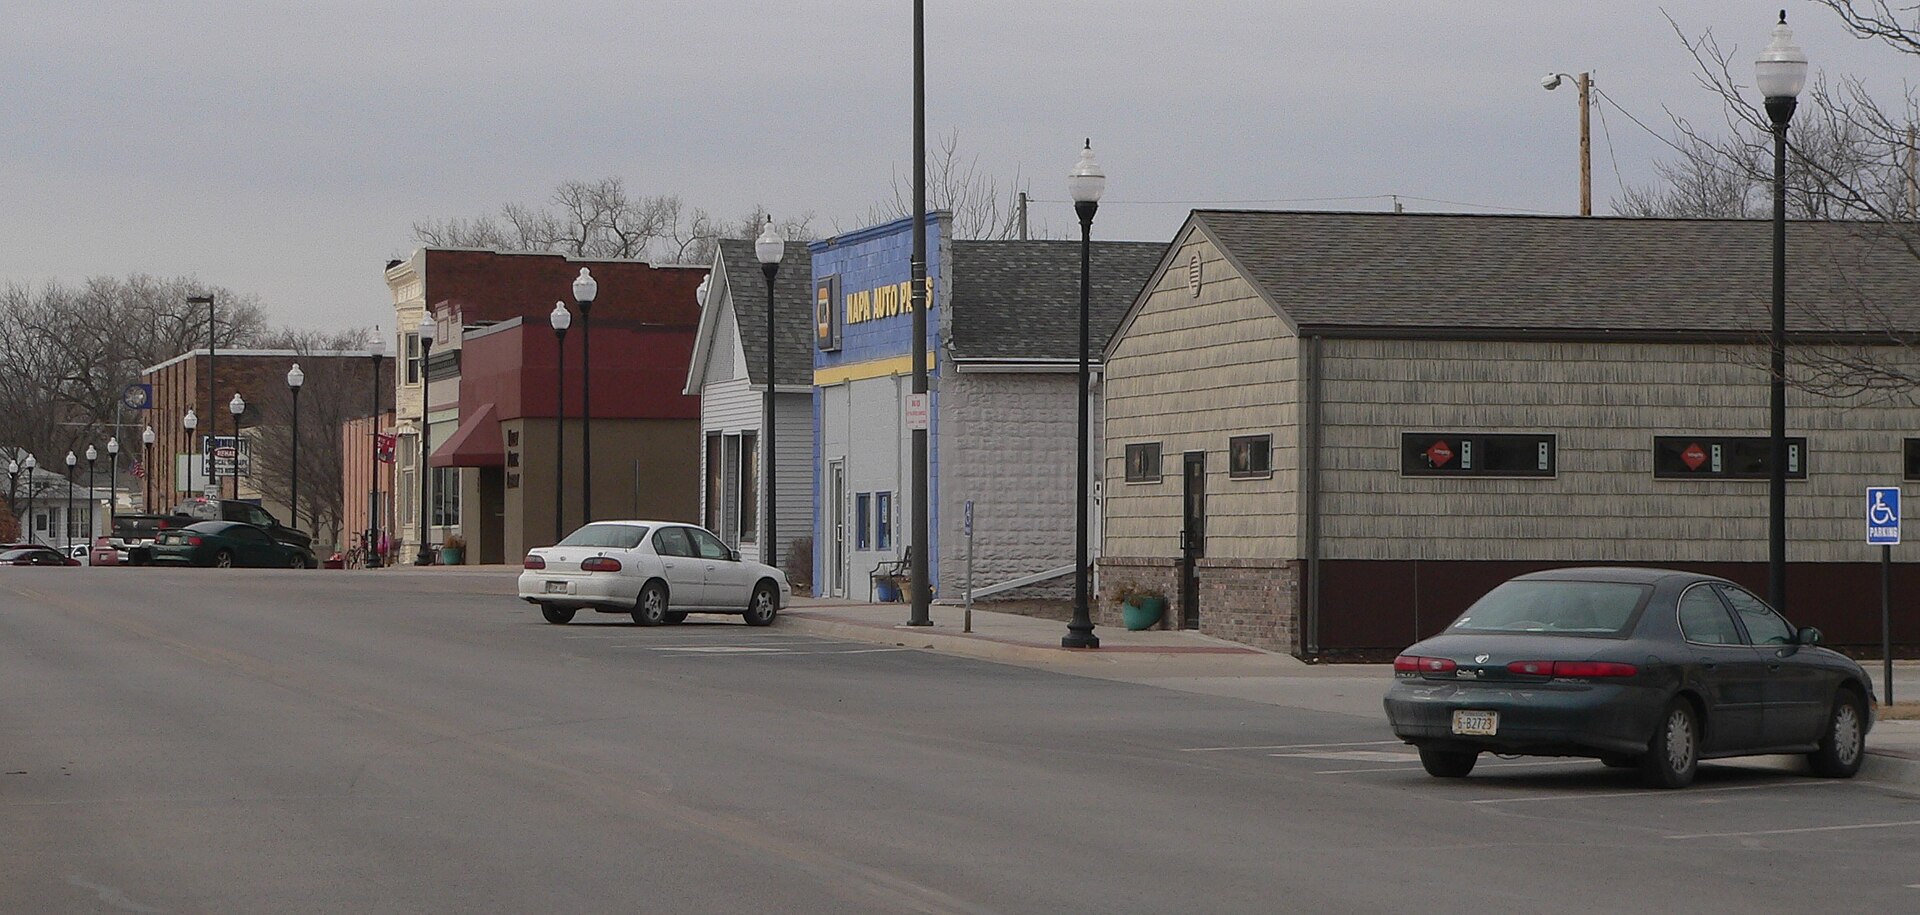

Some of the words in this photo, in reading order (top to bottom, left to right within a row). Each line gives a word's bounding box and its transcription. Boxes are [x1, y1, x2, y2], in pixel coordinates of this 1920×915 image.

[847, 290, 871, 324] NAPA
[873, 284, 898, 319] AUTO
[900, 276, 934, 314] PAS
[1870, 526, 1898, 538] PARKING
